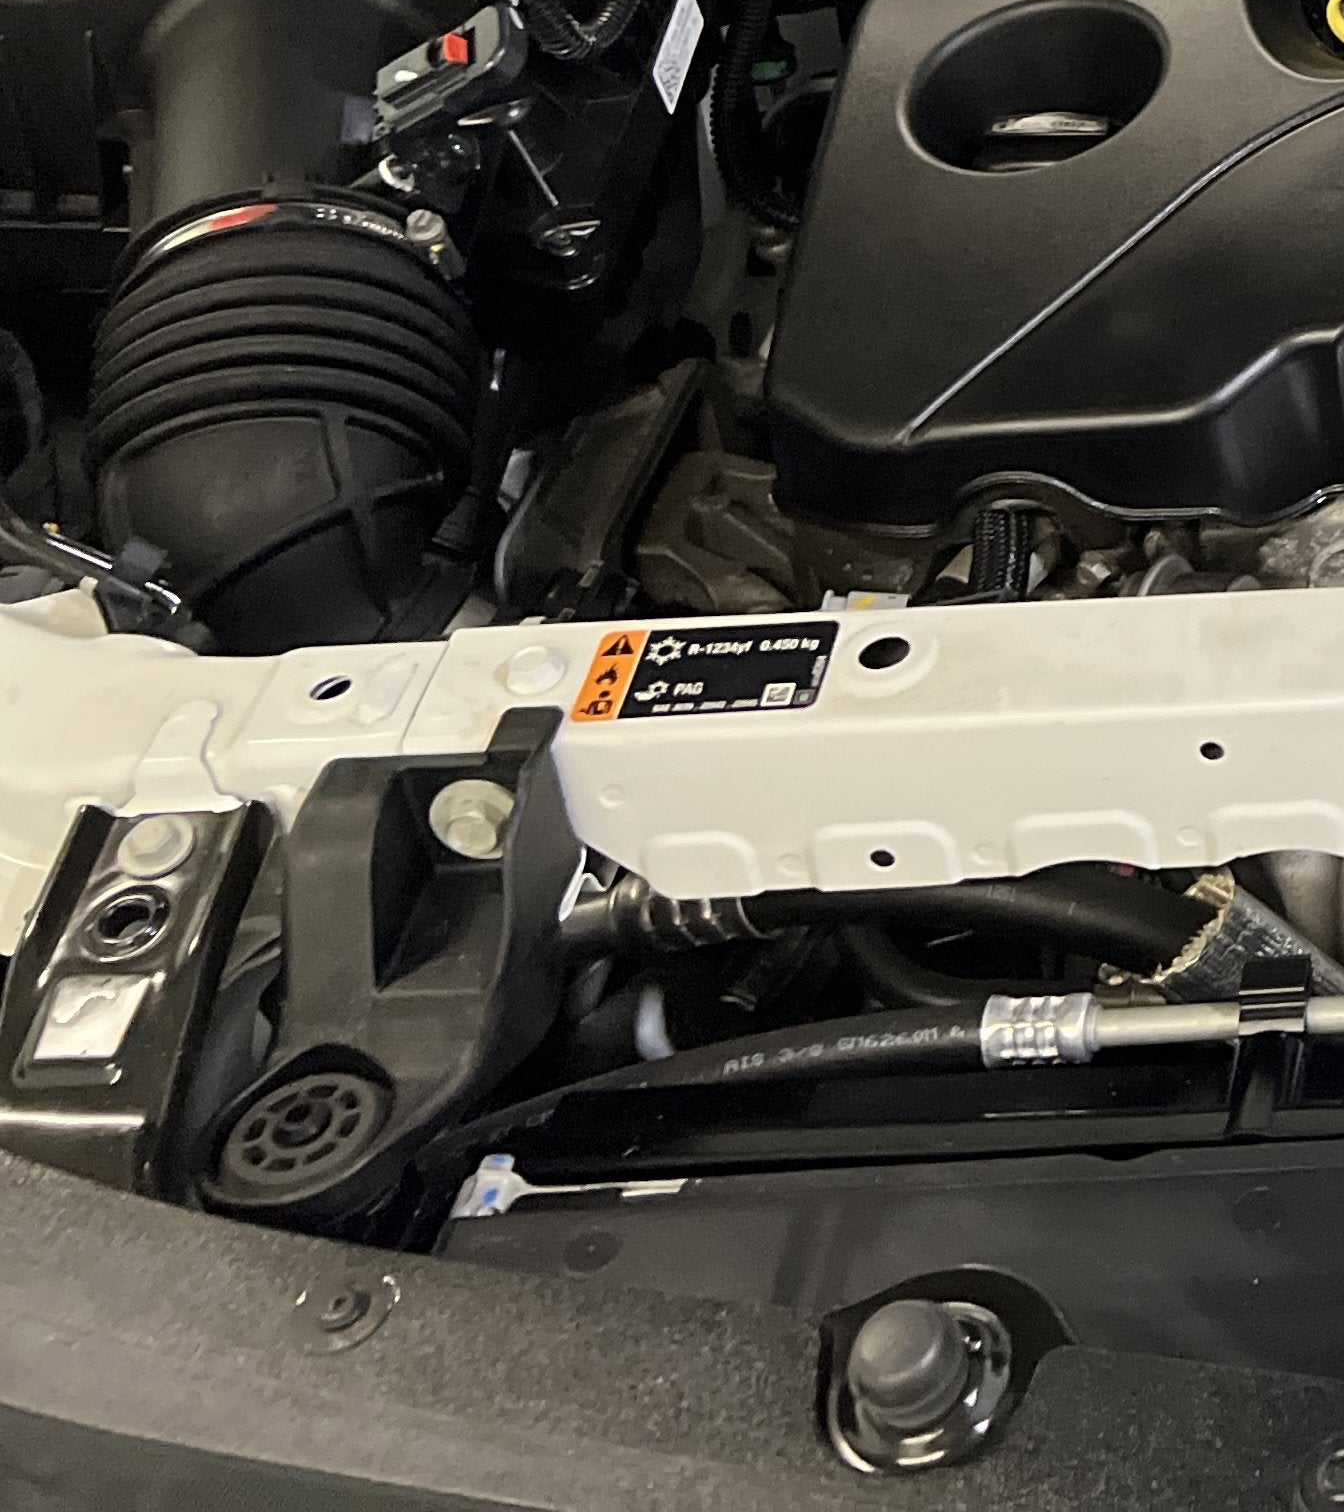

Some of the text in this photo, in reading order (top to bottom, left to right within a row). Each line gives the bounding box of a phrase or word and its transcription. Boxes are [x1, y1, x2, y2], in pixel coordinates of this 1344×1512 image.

[687, 640, 753, 656] R-1234yf
[800, 637, 820, 652] kg
[673, 681, 704, 697] PAG
